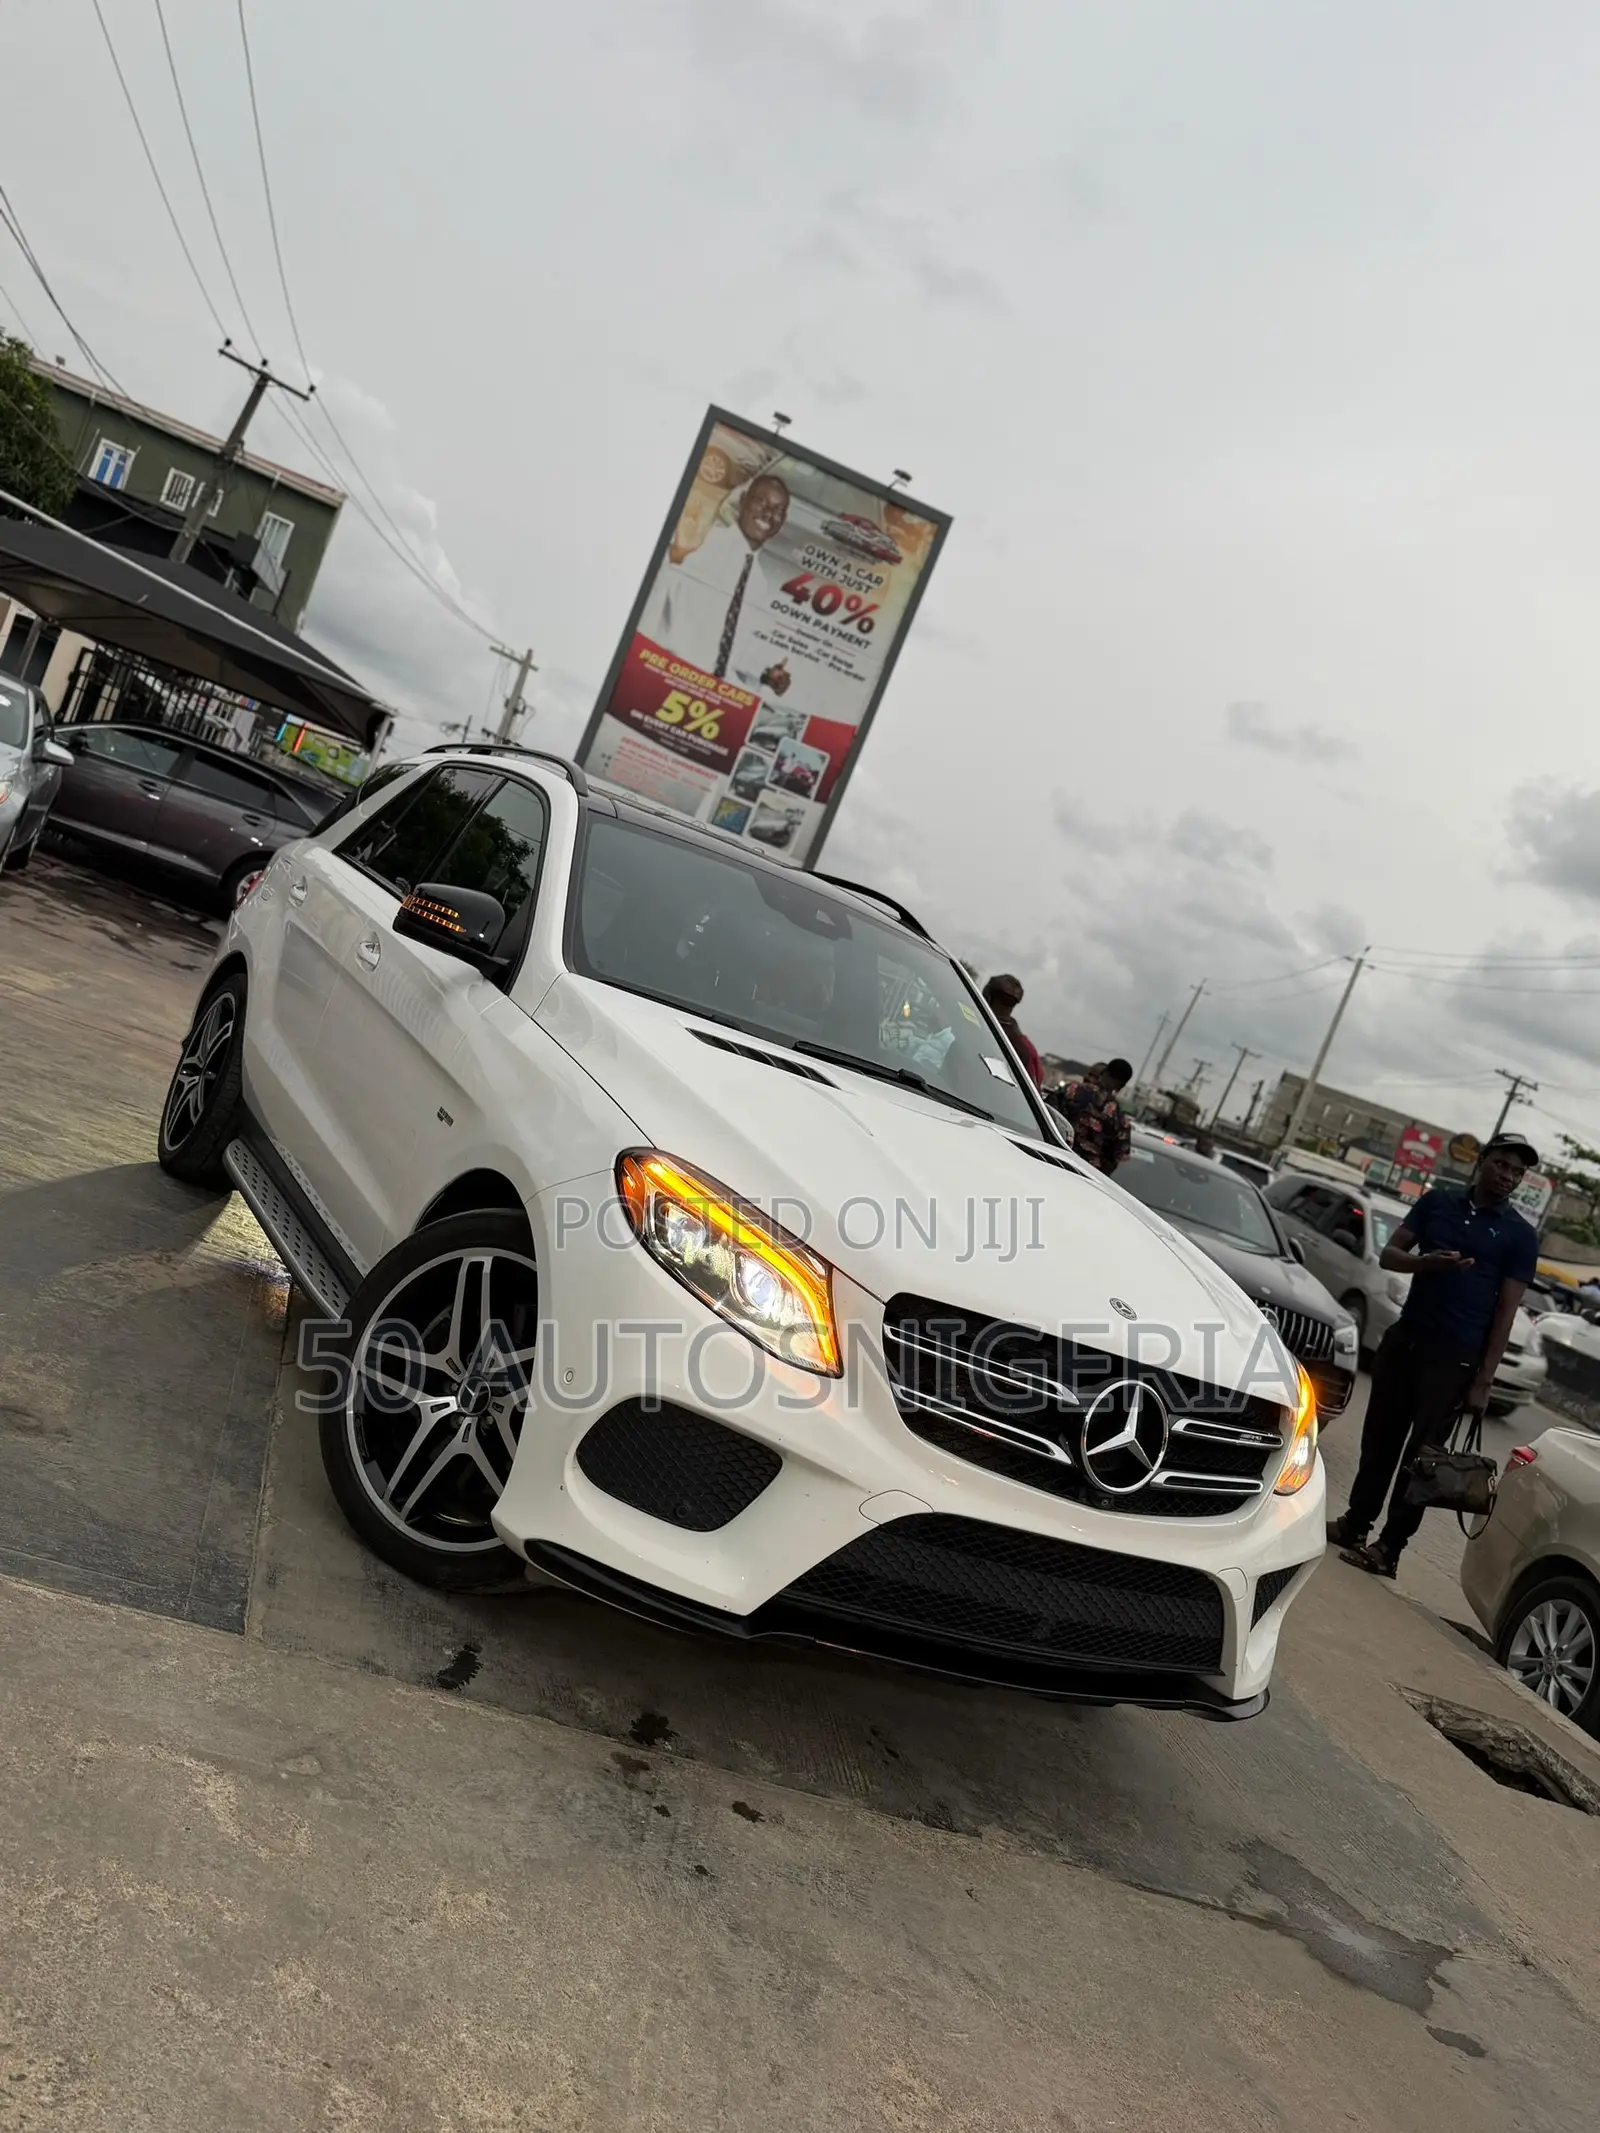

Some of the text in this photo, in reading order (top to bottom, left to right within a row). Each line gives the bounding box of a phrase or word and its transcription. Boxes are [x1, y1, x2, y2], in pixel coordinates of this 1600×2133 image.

[802, 556, 872, 594] WITH JUST
[805, 545, 839, 566] OWN
[842, 563, 852, 573] A
[856, 568, 884, 586] CAR
[770, 600, 871, 649] DOWN PAYMENT
[780, 572, 879, 634] 40%
[639, 649, 668, 669] PRE
[669, 662, 717, 689] ORDER
[718, 684, 755, 706] CARS
[655, 689, 725, 740] 5%
